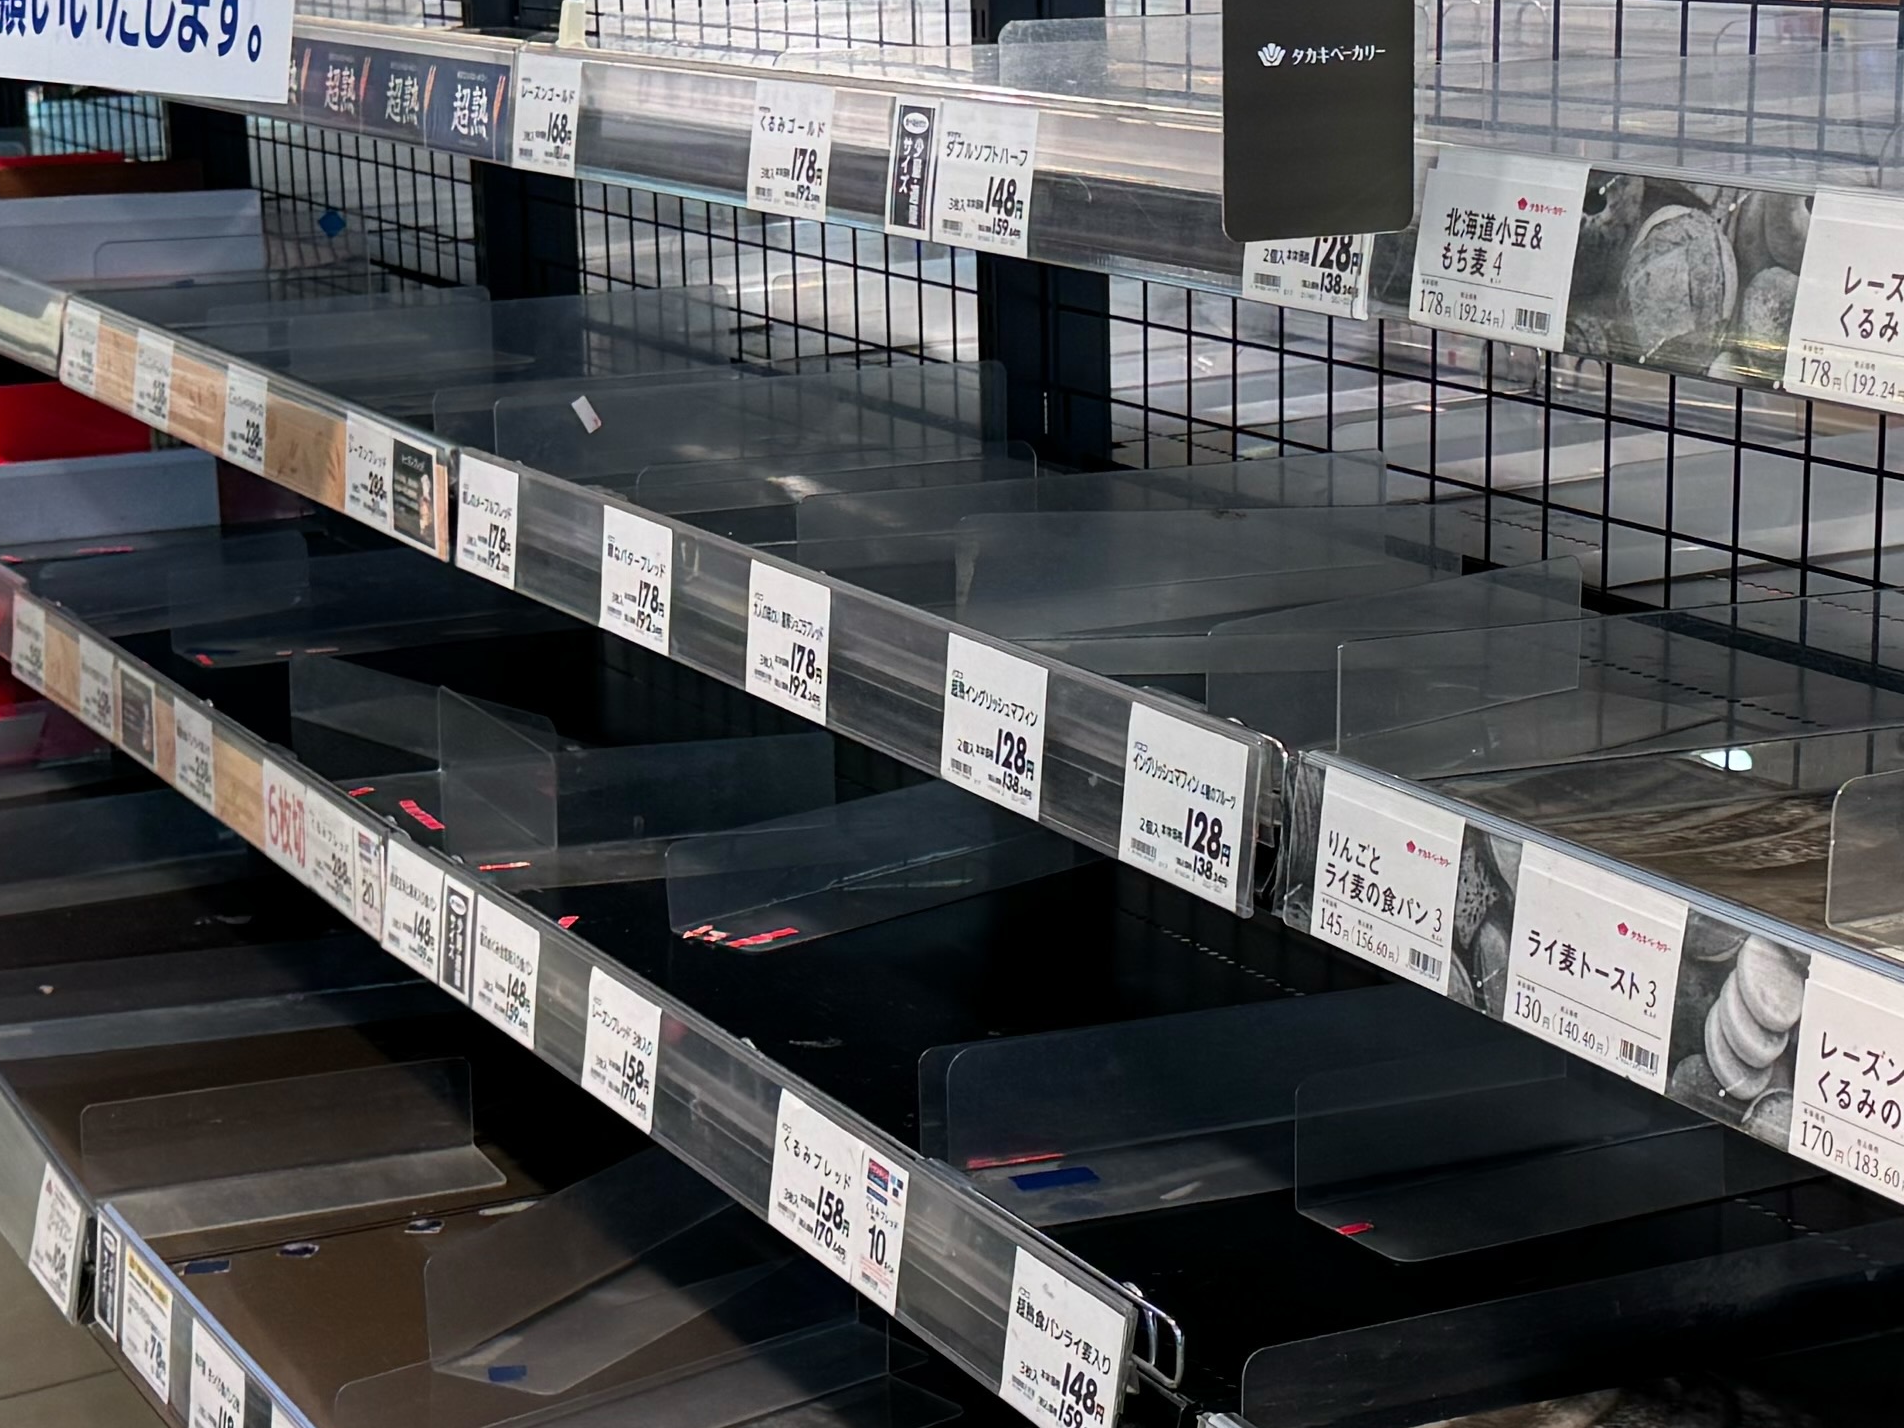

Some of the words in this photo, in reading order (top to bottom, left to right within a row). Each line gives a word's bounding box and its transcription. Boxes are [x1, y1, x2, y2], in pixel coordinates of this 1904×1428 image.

[1291, 44, 1386, 65] タカキベーカリー
[385, 75, 419, 126] 超熟
[451, 84, 489, 140] 超熟
[758, 114, 825, 138] くるみゴールド
[791, 148, 822, 187] 178円
[946, 141, 1028, 166] ダブルソフトハーフ
[985, 176, 1023, 220] 148円
[1445, 207, 1544, 251] 北海道小豆&
[1441, 244, 1487, 278] もち麦
[1492, 250, 1504, 275] 4
[1418, 287, 1452, 319] 178円
[1839, 303, 1899, 342] くるみ
[1798, 356, 1841, 391] 178円
[488, 524, 511, 556] 178円
[638, 580, 665, 619] 178円
[790, 642, 823, 685] 178円
[995, 728, 1035, 782] 128円
[1133, 753, 1198, 794] イングリッシュマフィン
[1139, 817, 1160, 838] 2個入
[1183, 807, 1231, 868] 128円
[1328, 830, 1380, 875] りんごと
[1325, 863, 1428, 926] ライ麦の食パン
[1433, 908, 1442, 933] 3
[1320, 907, 1350, 941] 145円
[1351, 925, 1400, 965] (156.60円)
[1528, 929, 1640, 1002] ライ麦トースト
[1648, 980, 1657, 1008] 3
[506, 972, 530, 1014] 148円
[1514, 992, 1550, 1030] 130円
[1553, 1014, 1609, 1055] (140.40円)
[622, 1050, 649, 1095] 158円
[783, 1135, 851, 1189] くるみブレッド
[1799, 1121, 1844, 1163] 170円
[816, 1186, 849, 1238] 158円
[868, 1224, 886, 1266] 10
[1016, 1295, 1111, 1374] 超熟食パンライ麦入り
[1061, 1362, 1105, 1426] 148円
